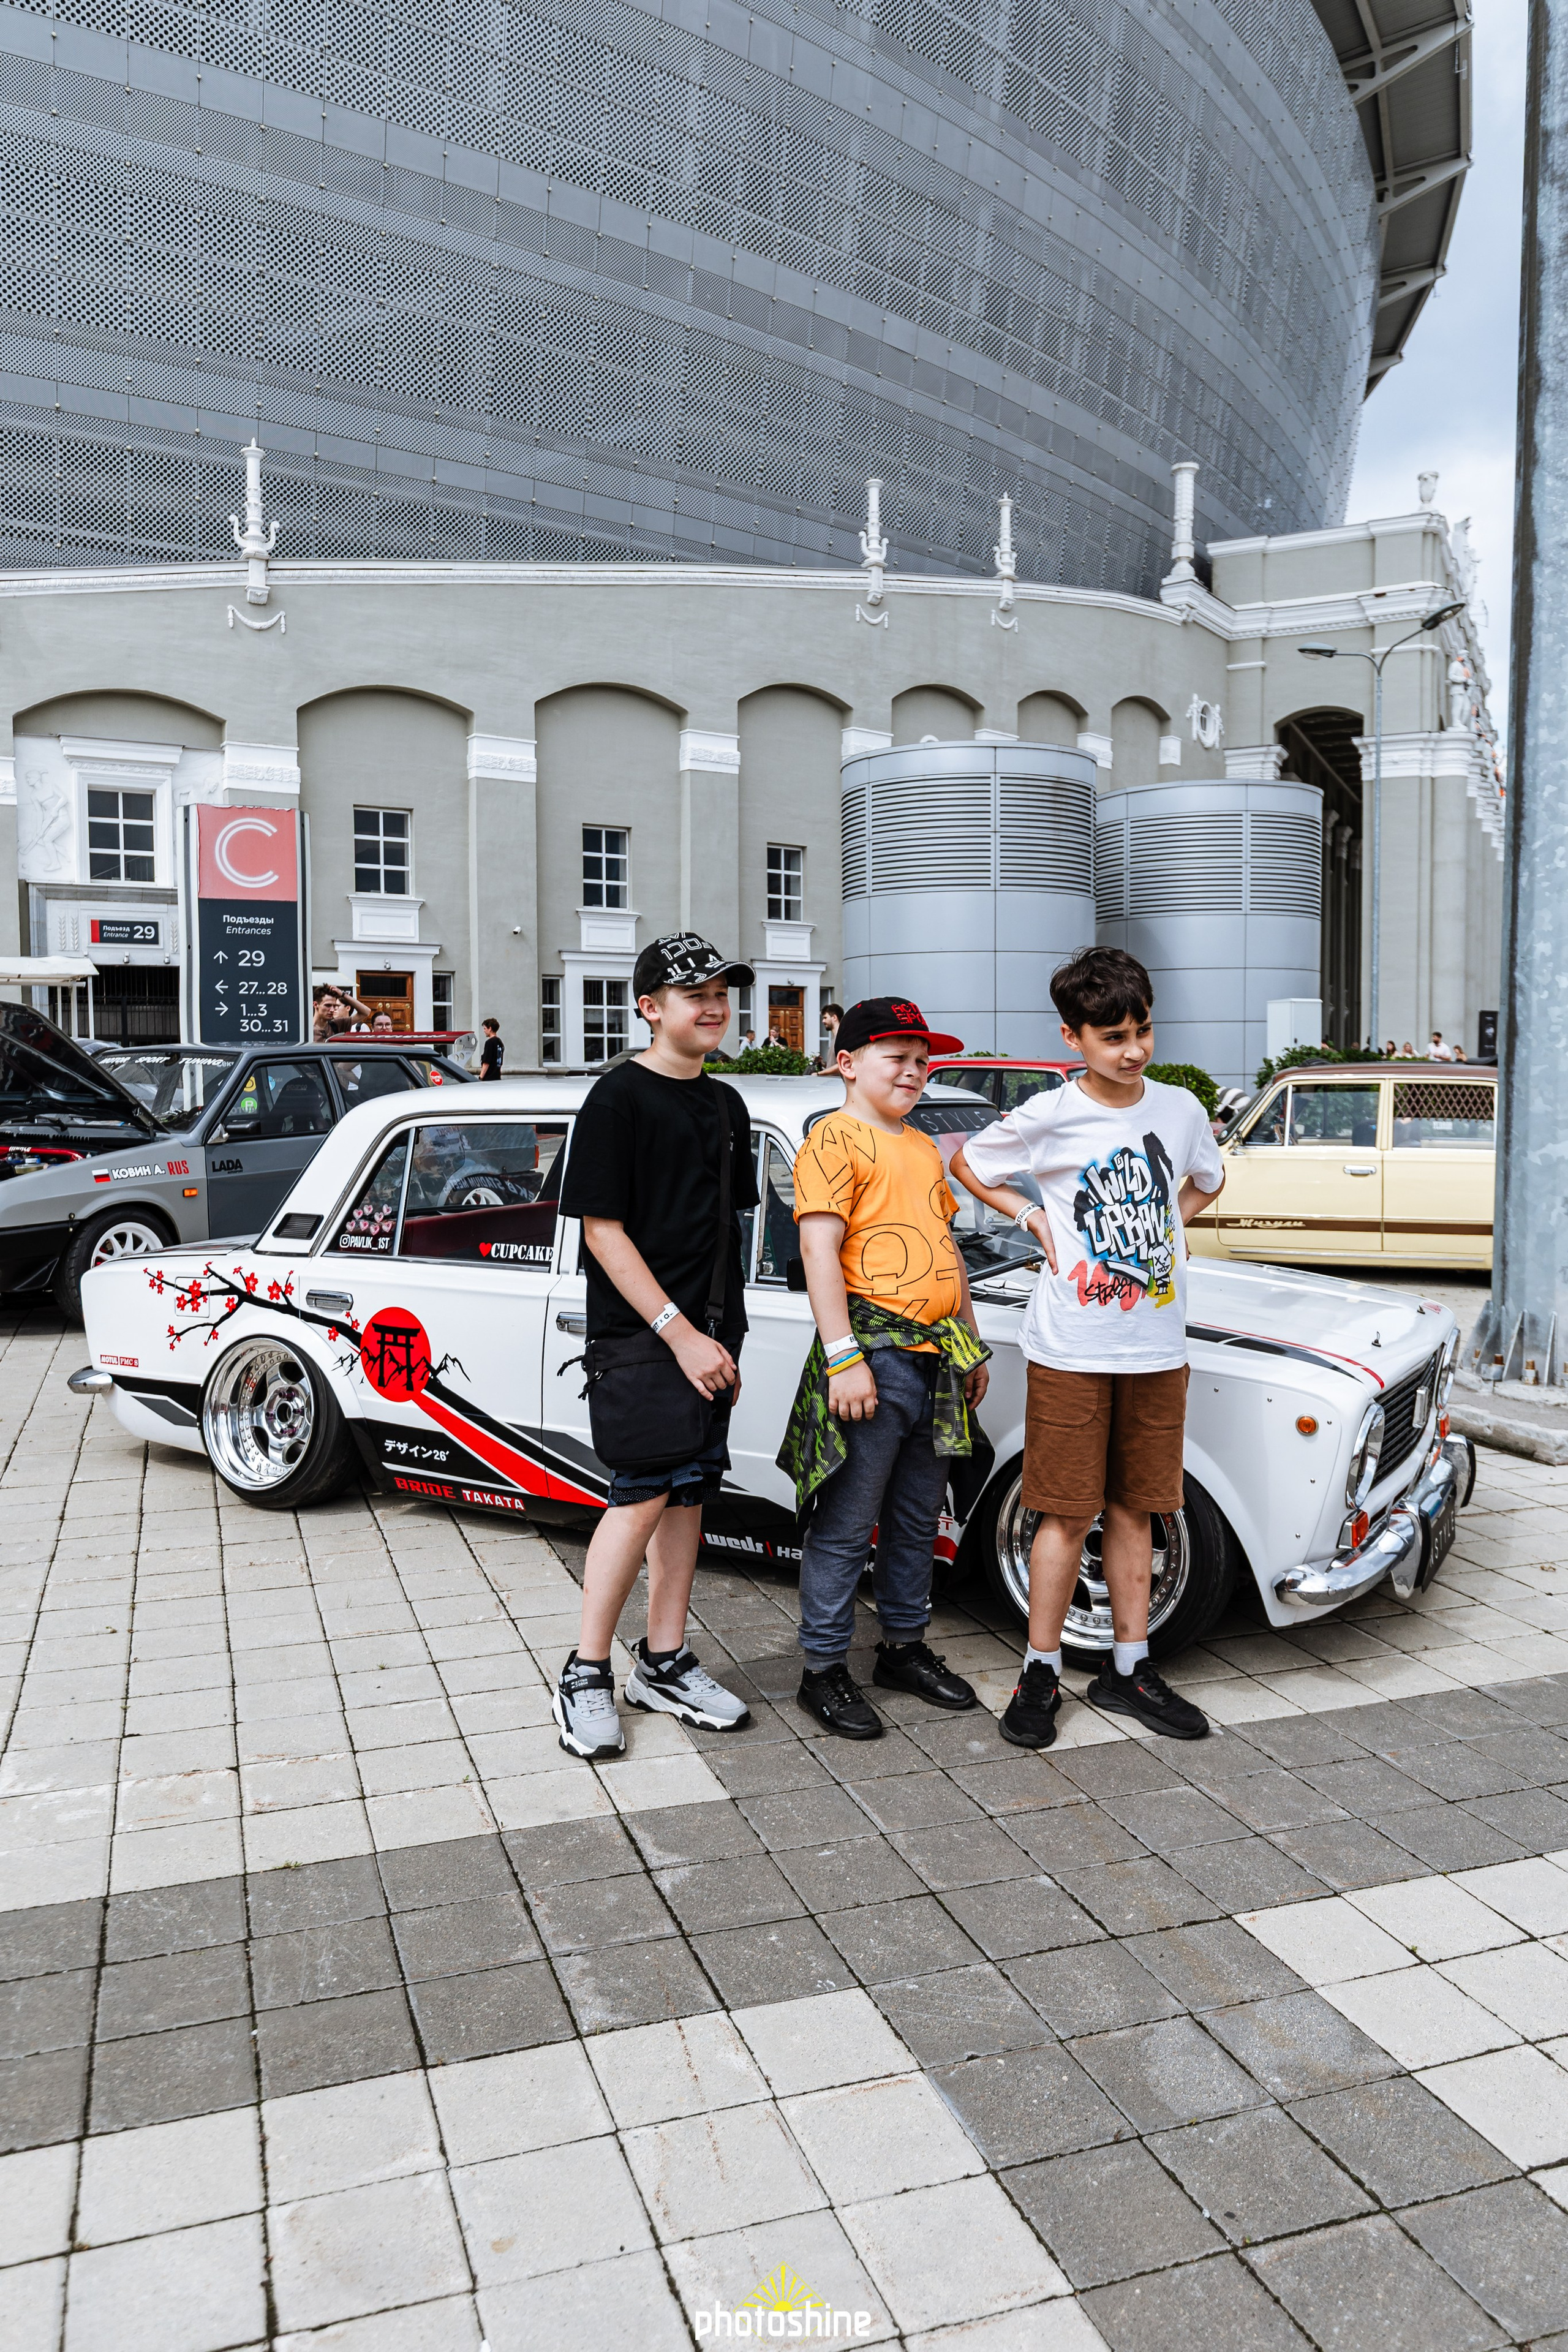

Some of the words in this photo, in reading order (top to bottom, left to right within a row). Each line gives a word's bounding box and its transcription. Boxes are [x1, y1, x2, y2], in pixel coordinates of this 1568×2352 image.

[223, 914, 274, 924] Подъезды
[134, 925, 155, 939] 29
[226, 926, 271, 935] Entrances
[238, 950, 265, 967] 29
[178, 1057, 223, 1066] TUNING
[111, 1165, 151, 1180] КОВИН
[167, 1160, 189, 1175] RUS
[212, 1159, 243, 1172] LADA
[1084, 1201, 1166, 1263] URBAN
[491, 1243, 554, 1261] CUPCAKE
[101, 1355, 118, 1364] MOTUL
[394, 1477, 456, 1499] BRIDE
[462, 1489, 525, 1510] TAKATA
[705, 1532, 764, 1553] weds
